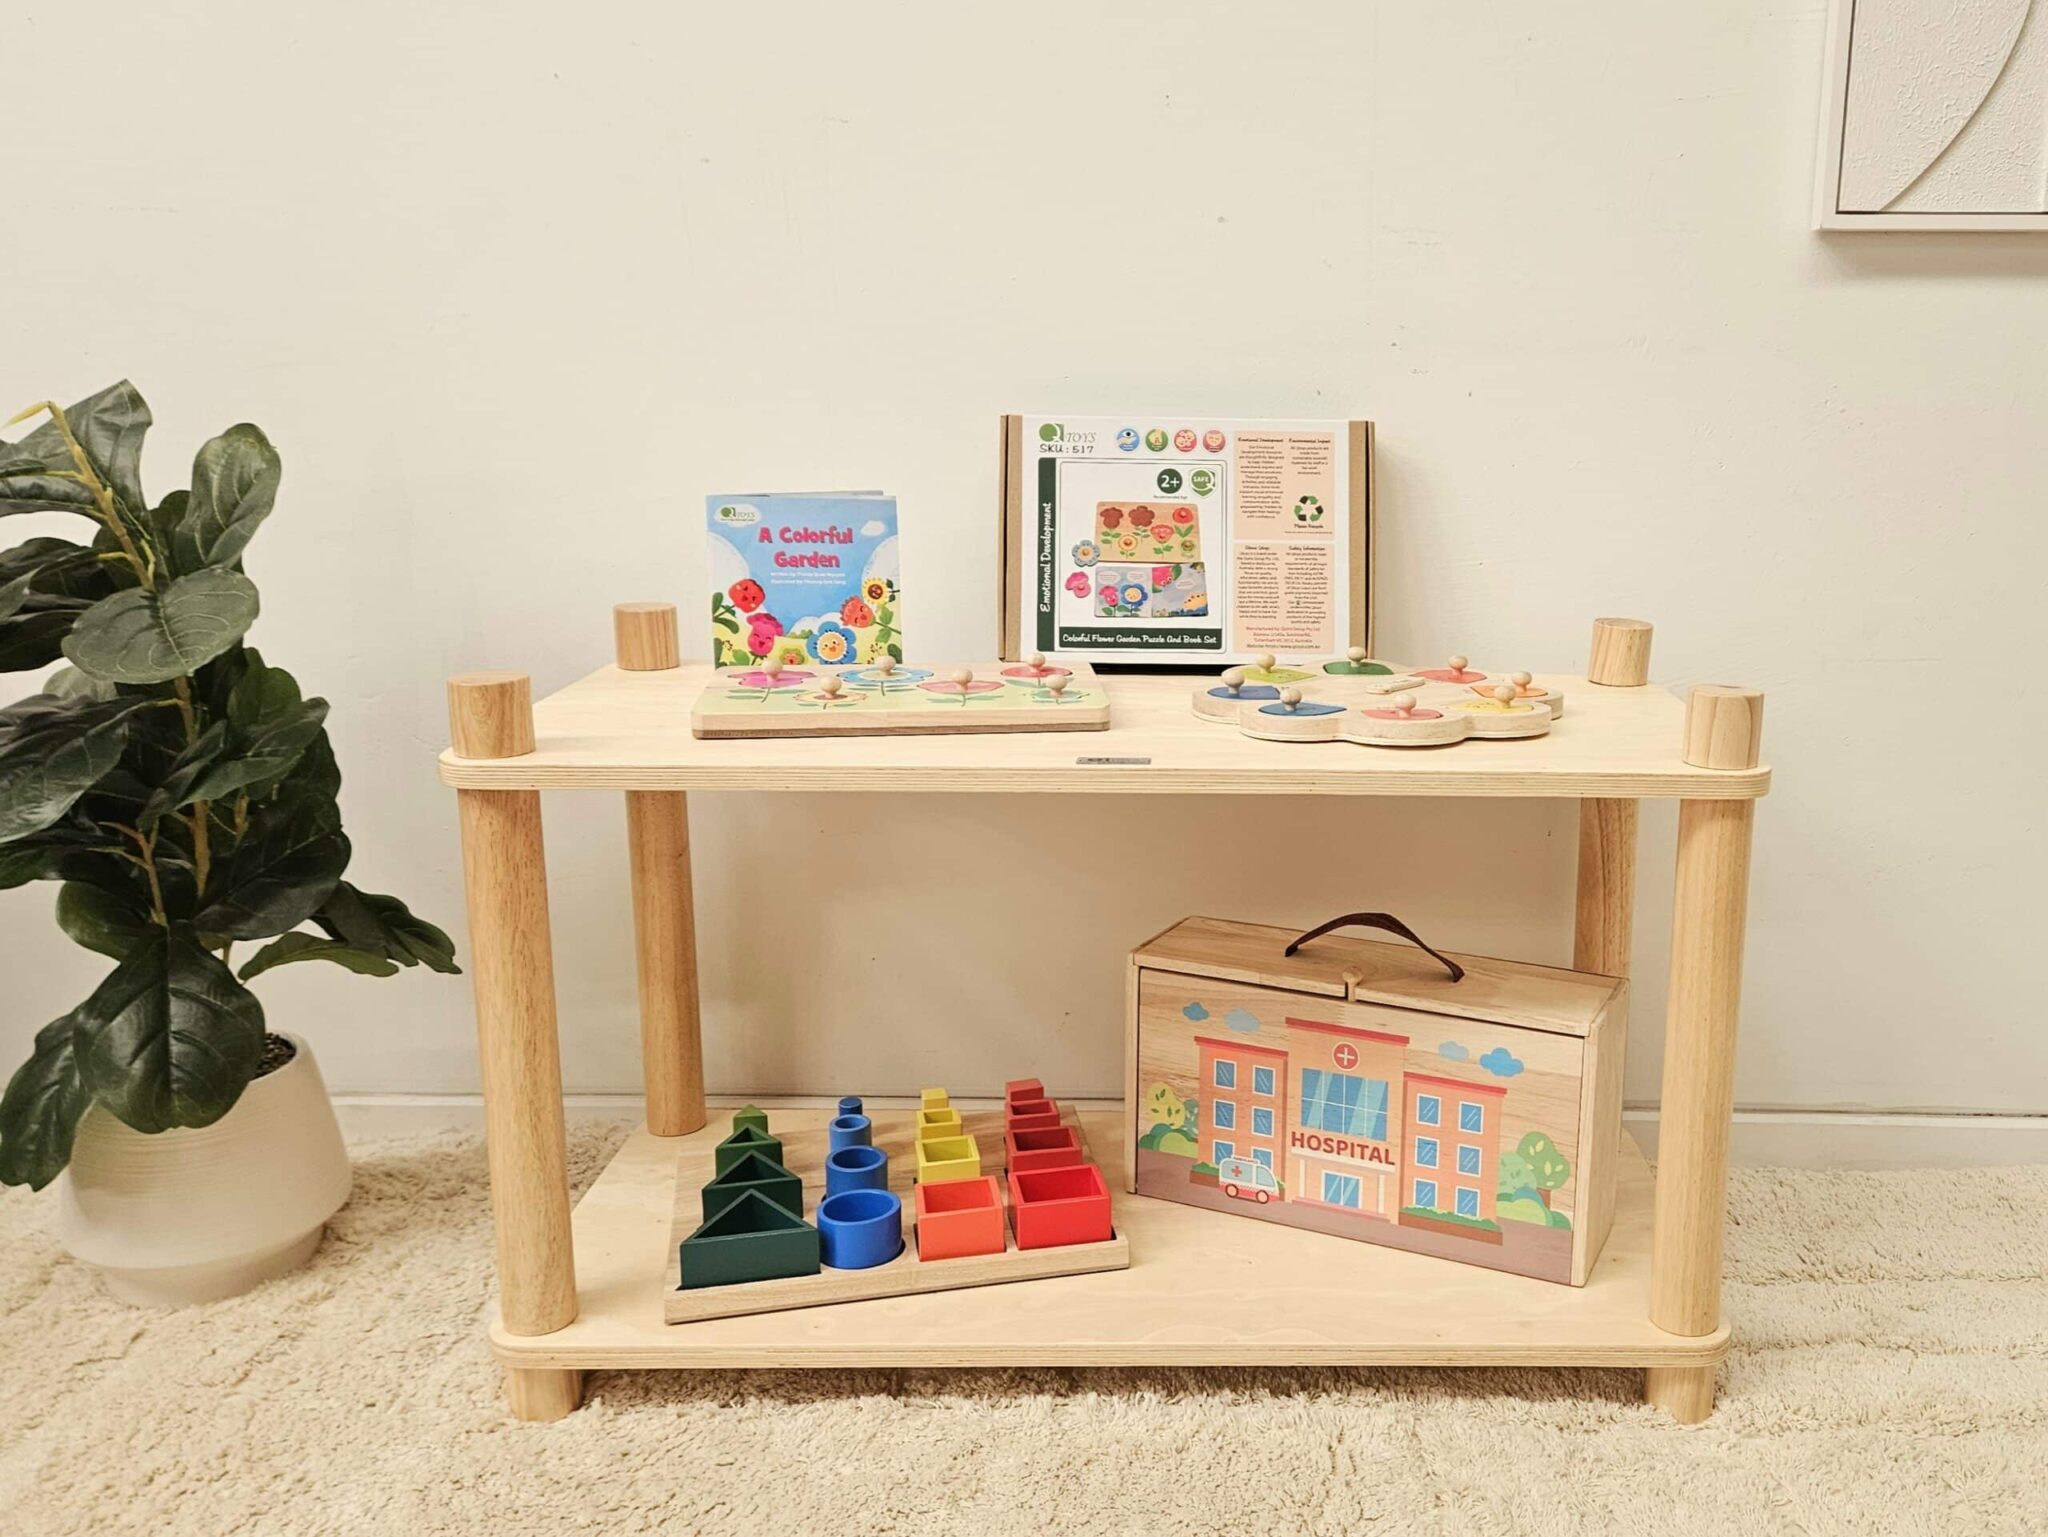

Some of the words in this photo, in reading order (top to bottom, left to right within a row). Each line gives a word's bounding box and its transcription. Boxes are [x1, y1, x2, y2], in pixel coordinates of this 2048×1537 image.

[1072, 445, 1094, 454] 517
[1160, 475, 1180, 488] 2+
[1192, 475, 1209, 483] SAFE
[758, 527, 773, 543] A
[779, 525, 853, 544] Colorful
[1040, 501, 1054, 562] Development
[774, 550, 840, 568] Garden
[1040, 562, 1051, 613] Emotional
[1062, 633, 1091, 642] Colorful
[1092, 634, 1115, 642] Flower
[1116, 634, 1142, 643] Garden
[1142, 634, 1165, 643] Puzzle
[1167, 634, 1181, 643] And
[1183, 635, 1202, 643] Book
[1203, 635, 1217, 644] Set
[1291, 1131, 1395, 1166] HOSPITAL
